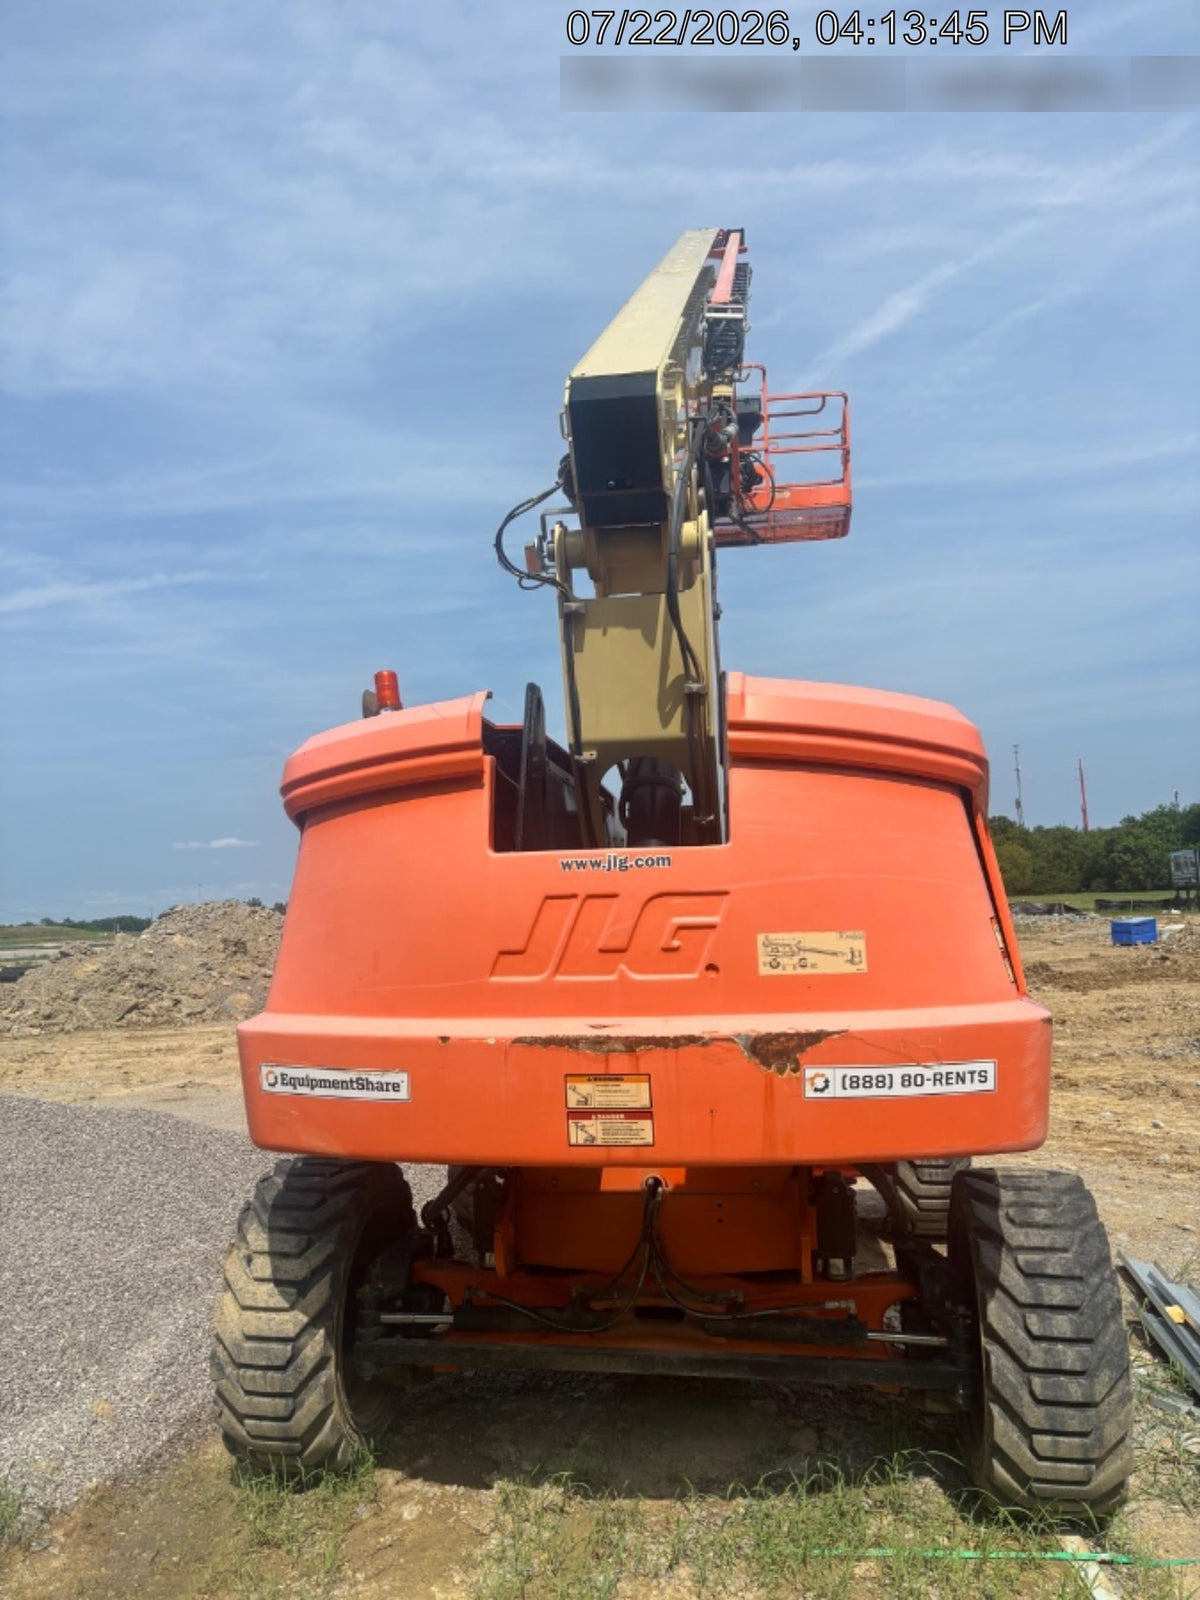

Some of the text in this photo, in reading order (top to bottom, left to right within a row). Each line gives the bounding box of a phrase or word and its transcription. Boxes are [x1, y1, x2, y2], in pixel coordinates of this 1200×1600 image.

[560, 855, 671, 872] www.jlg.com
[488, 891, 731, 984] JLG
[280, 1073, 401, 1092] EquipmentShare
[841, 1069, 989, 1091] (888) 80-RENTS
